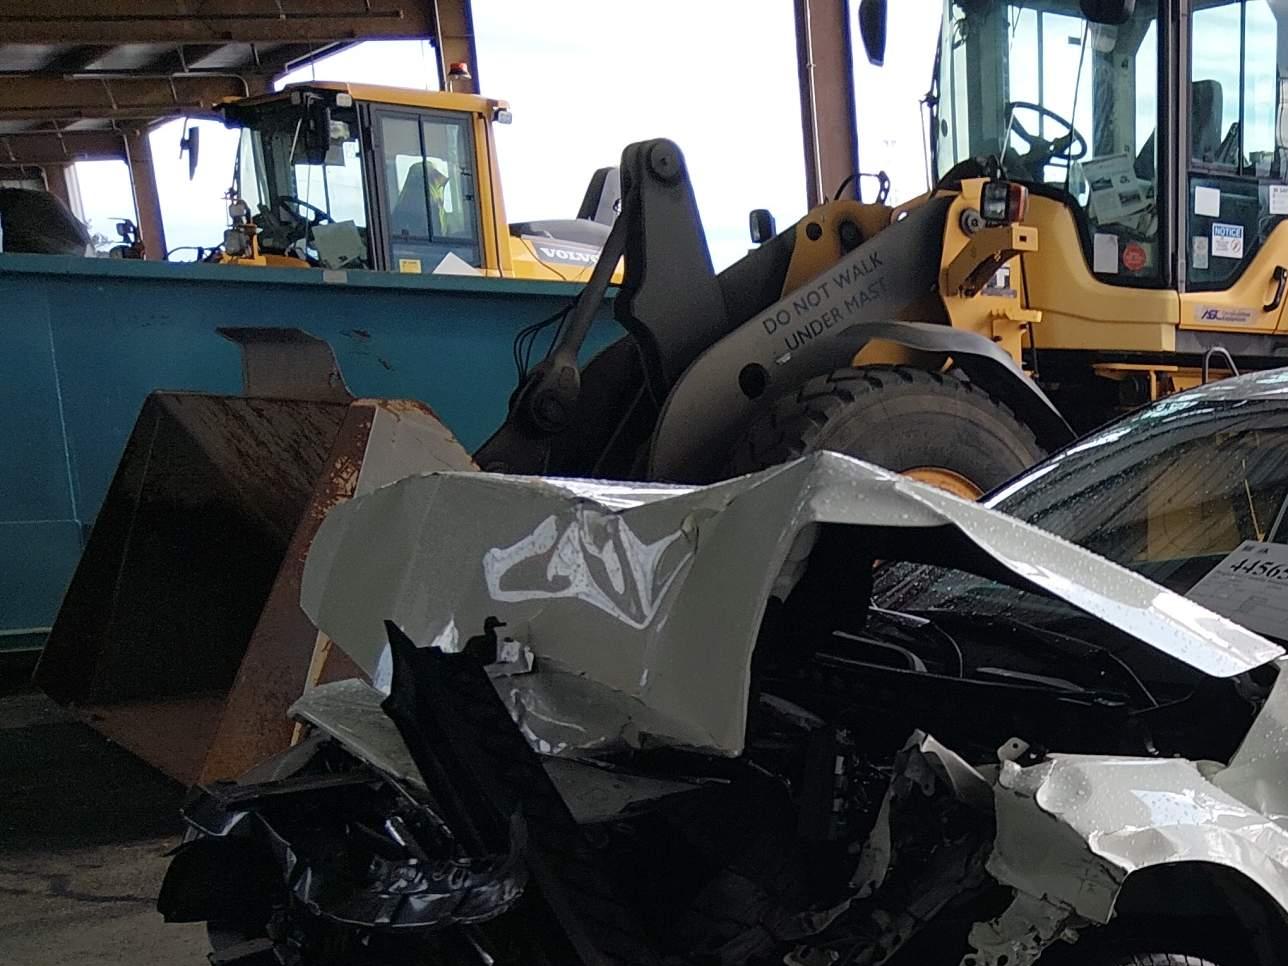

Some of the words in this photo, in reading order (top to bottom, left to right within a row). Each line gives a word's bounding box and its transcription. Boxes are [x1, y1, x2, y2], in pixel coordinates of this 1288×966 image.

[1215, 227, 1240, 238] NOTICE
[762, 309, 791, 335] DO
[793, 283, 830, 315] NOT
[833, 251, 883, 289] WALK
[784, 306, 844, 351] UNDER
[844, 277, 886, 313] MAST
